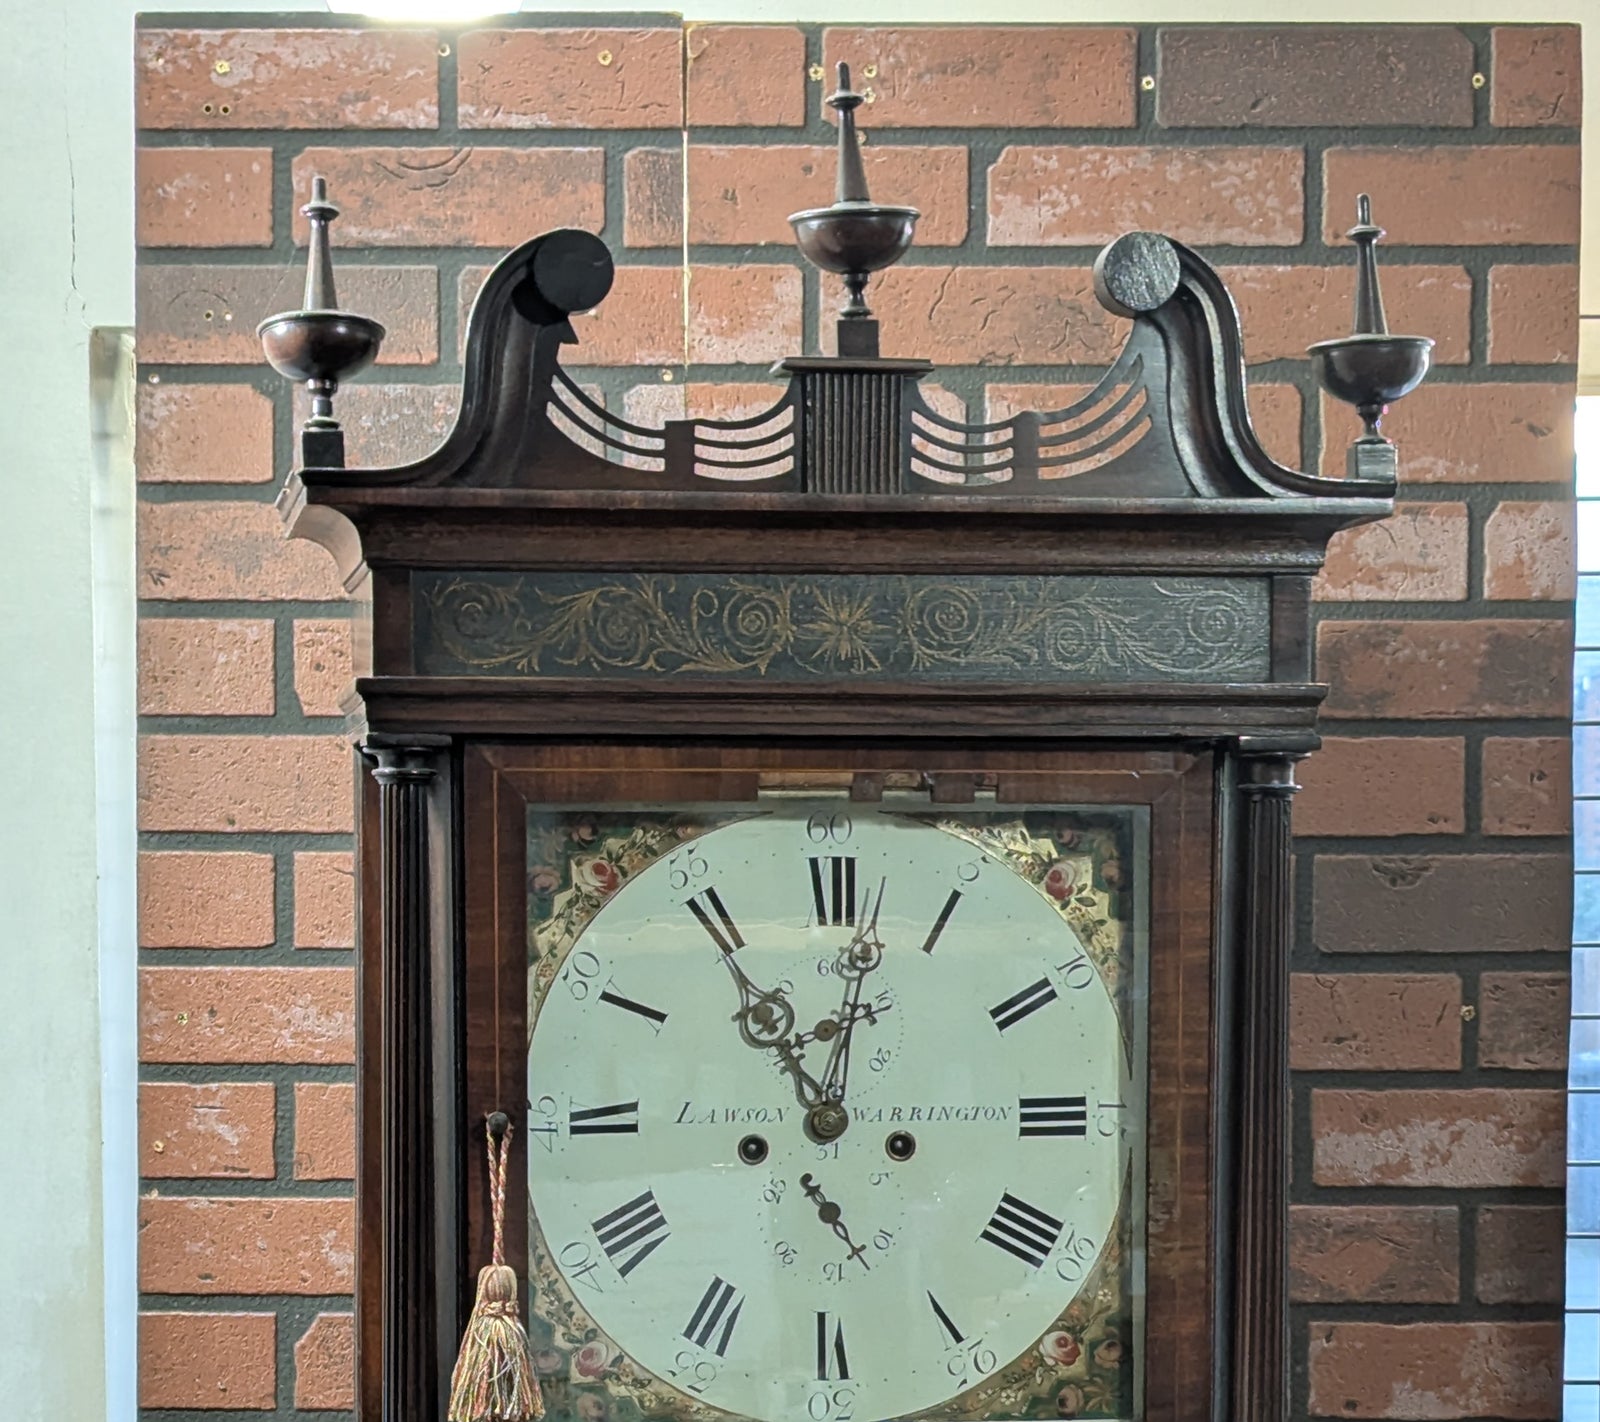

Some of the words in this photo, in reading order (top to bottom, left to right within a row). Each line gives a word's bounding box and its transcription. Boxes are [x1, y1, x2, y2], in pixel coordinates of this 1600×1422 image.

[807, 810, 852, 845] 60
[668, 843, 708, 890] 55
[802, 856, 858, 928] XII
[917, 887, 964, 956] I
[562, 951, 600, 1000] 50
[1054, 946, 1094, 989] 10
[985, 971, 1061, 1037] II
[869, 1047, 892, 1072] 20
[528, 1095, 559, 1154] 45
[568, 1096, 640, 1139] IX
[674, 1101, 790, 1124] LAWSON
[853, 1105, 1012, 1123] WARRINGTON
[1018, 1091, 1088, 1141] III
[815, 1142, 840, 1161] 31
[763, 1178, 787, 1204] 25
[869, 1171, 889, 1186] 5
[590, 1185, 672, 1284] VIII
[774, 1240, 798, 1265] 20
[873, 1228, 894, 1250] 10
[974, 1186, 1066, 1273] IIII
[558, 1241, 604, 1294] 40
[822, 1262, 845, 1282] 15
[1055, 1229, 1096, 1283] 20
[680, 1274, 746, 1359] VII
[810, 1309, 856, 1381] VI
[947, 1338, 998, 1391] 25
[667, 1350, 717, 1394] 35
[808, 1387, 856, 1422] 30
